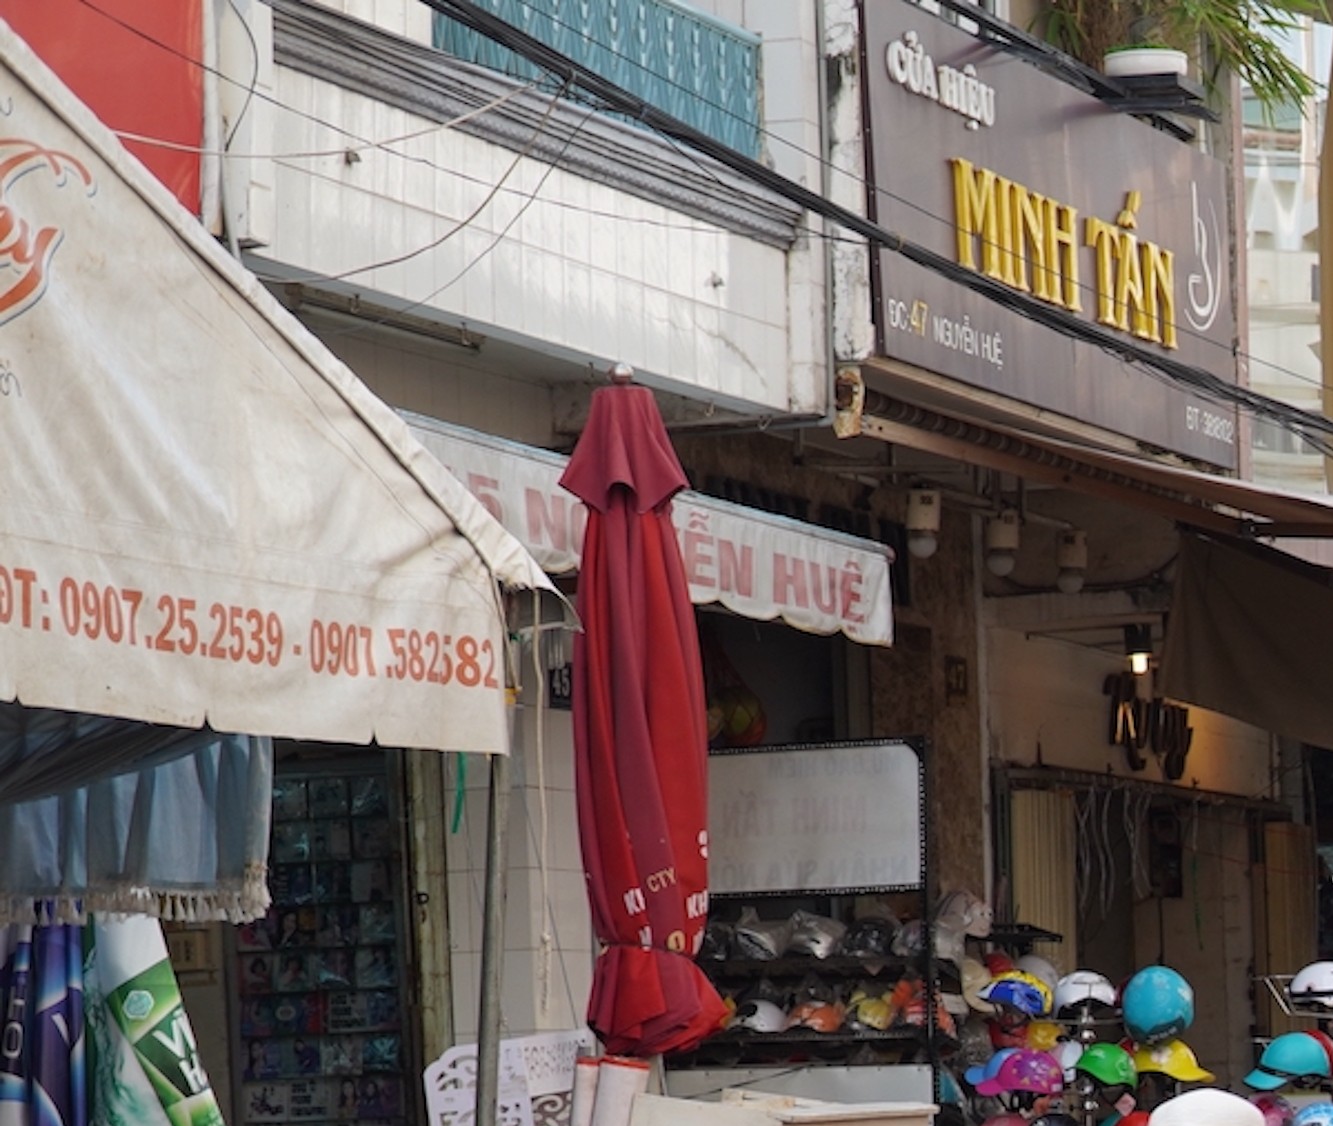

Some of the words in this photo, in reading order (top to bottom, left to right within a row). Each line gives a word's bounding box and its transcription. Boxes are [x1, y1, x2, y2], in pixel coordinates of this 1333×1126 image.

[885, 30, 938, 101] CỬA
[938, 63, 995, 130] HIỆU
[949, 157, 1083, 313] MINH
[1085, 190, 1178, 350] TẤN
[933, 315, 979, 358] NGUYỄN
[981, 331, 1004, 371] HUỆ
[525, 487, 753, 598] NỄN
[772, 551, 868, 632] HUỆ
[60, 576, 283, 667] 0907.25.2539
[553, 668, 572, 699] 45
[646, 867, 676, 893] CTY
